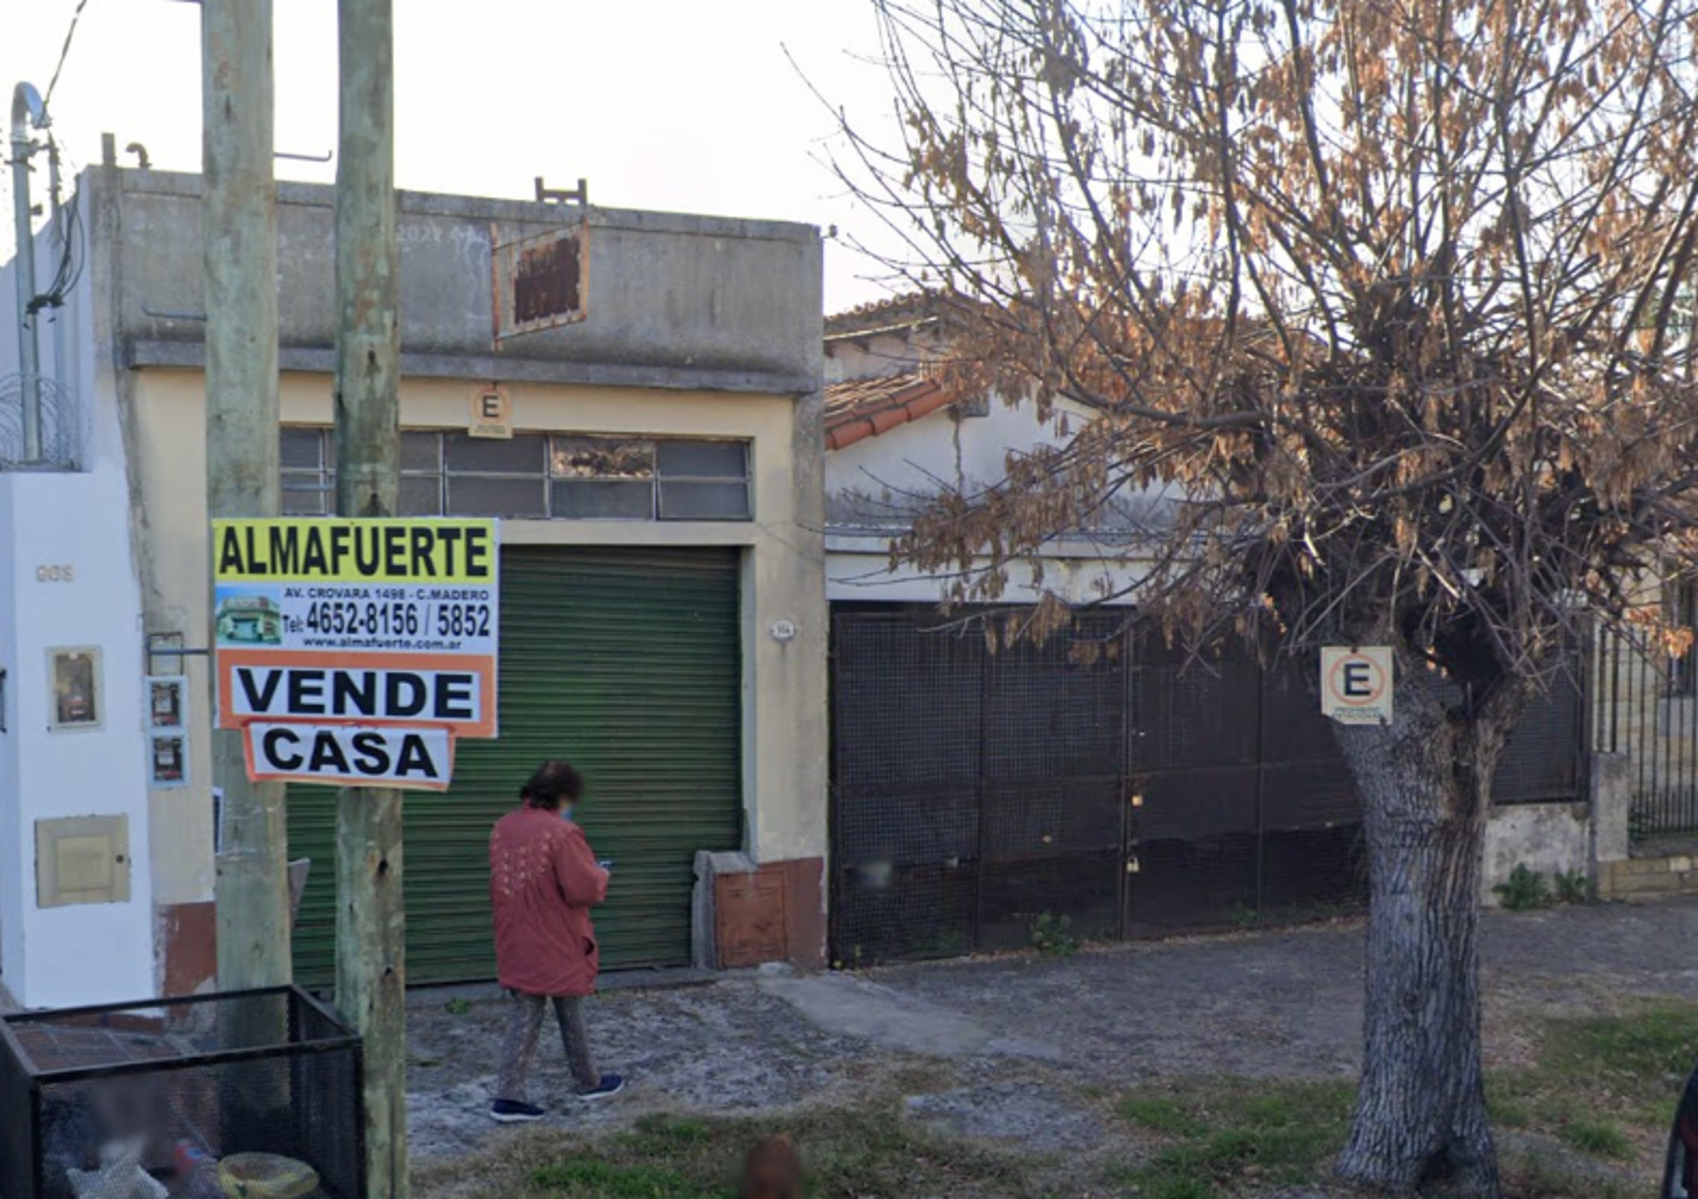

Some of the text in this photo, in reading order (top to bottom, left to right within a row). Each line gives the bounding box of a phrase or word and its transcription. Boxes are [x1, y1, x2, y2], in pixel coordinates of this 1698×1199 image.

[482, 395, 500, 418] E
[219, 526, 489, 577] ALMAFUERTE
[284, 588, 304, 599] AV.
[307, 587, 370, 599] CROVARA
[375, 588, 406, 600] 1498
[416, 588, 489, 601] C.MADERO
[282, 601, 490, 637] Tel: 4652-8156 / 5852
[303, 637, 462, 650] www.almafuerte.com.ar
[236, 668, 473, 719] VENDE
[1344, 663, 1372, 696] E
[262, 728, 439, 778] CASA
